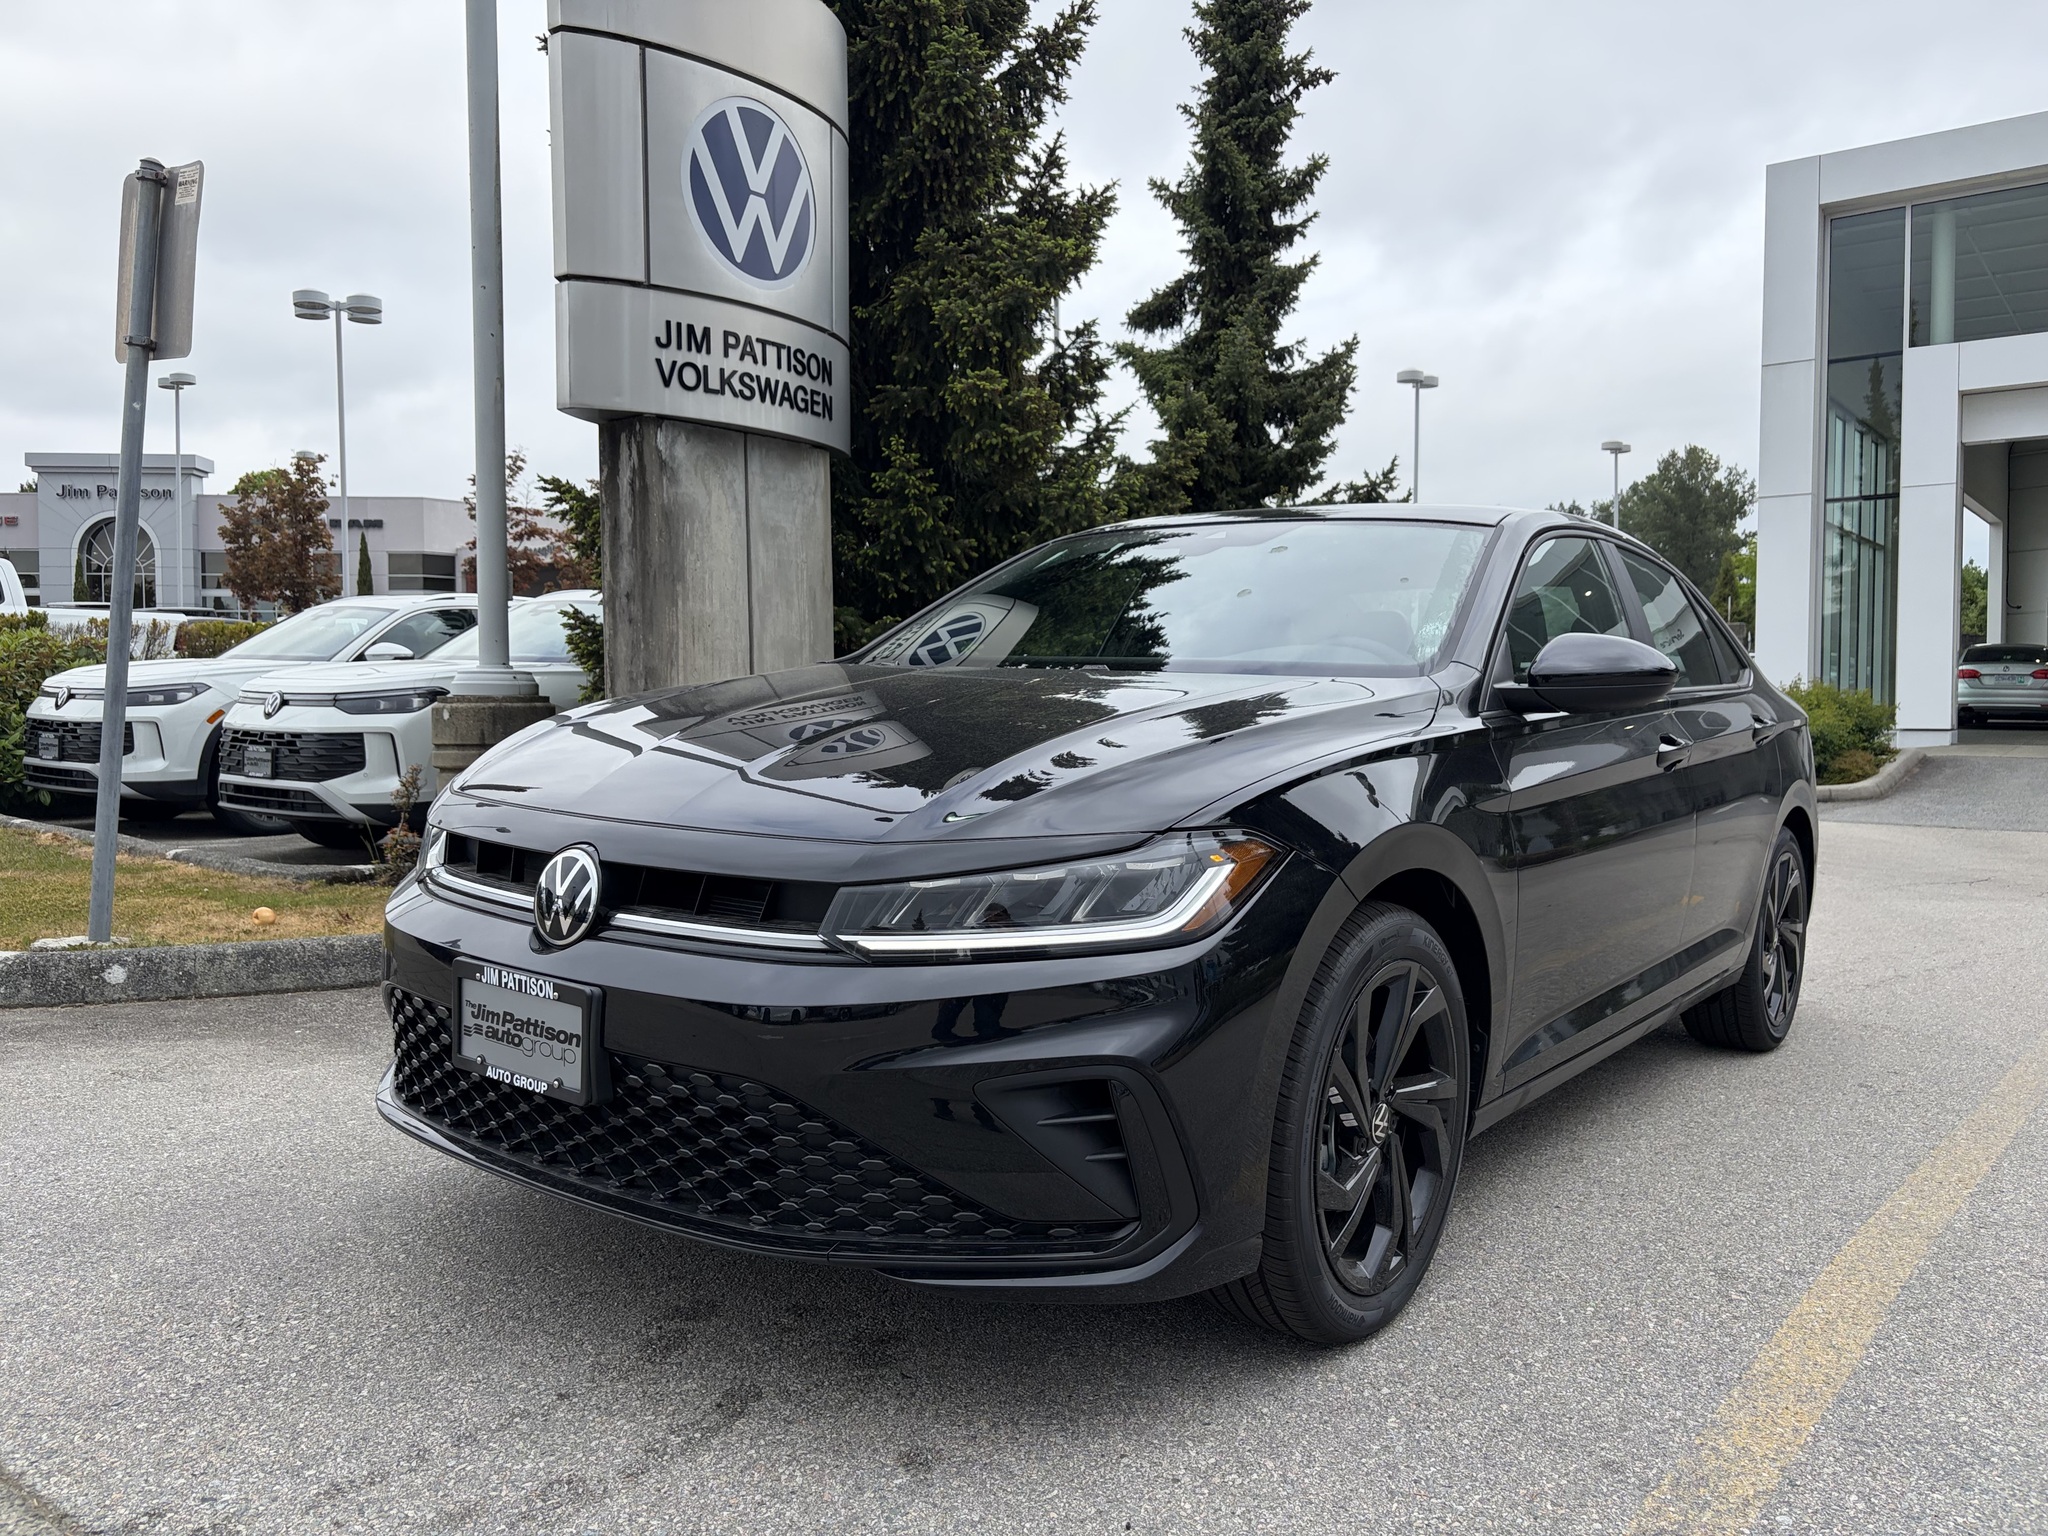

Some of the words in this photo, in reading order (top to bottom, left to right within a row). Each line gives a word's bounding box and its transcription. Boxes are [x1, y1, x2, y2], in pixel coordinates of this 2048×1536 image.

[685, 99, 815, 284] VW
[655, 319, 711, 355] JIM
[723, 330, 832, 386] PATTISON
[655, 358, 833, 421] VOLKSWAGEN
[56, 484, 90, 499] Jim
[97, 485, 174, 499] Pason
[536, 847, 599, 943] VW
[465, 1000, 478, 1010] The
[481, 966, 498, 985] JIM
[502, 971, 554, 999] PATTISON
[486, 1065, 511, 1084] AUTO
[513, 1074, 548, 1094] GROUP
